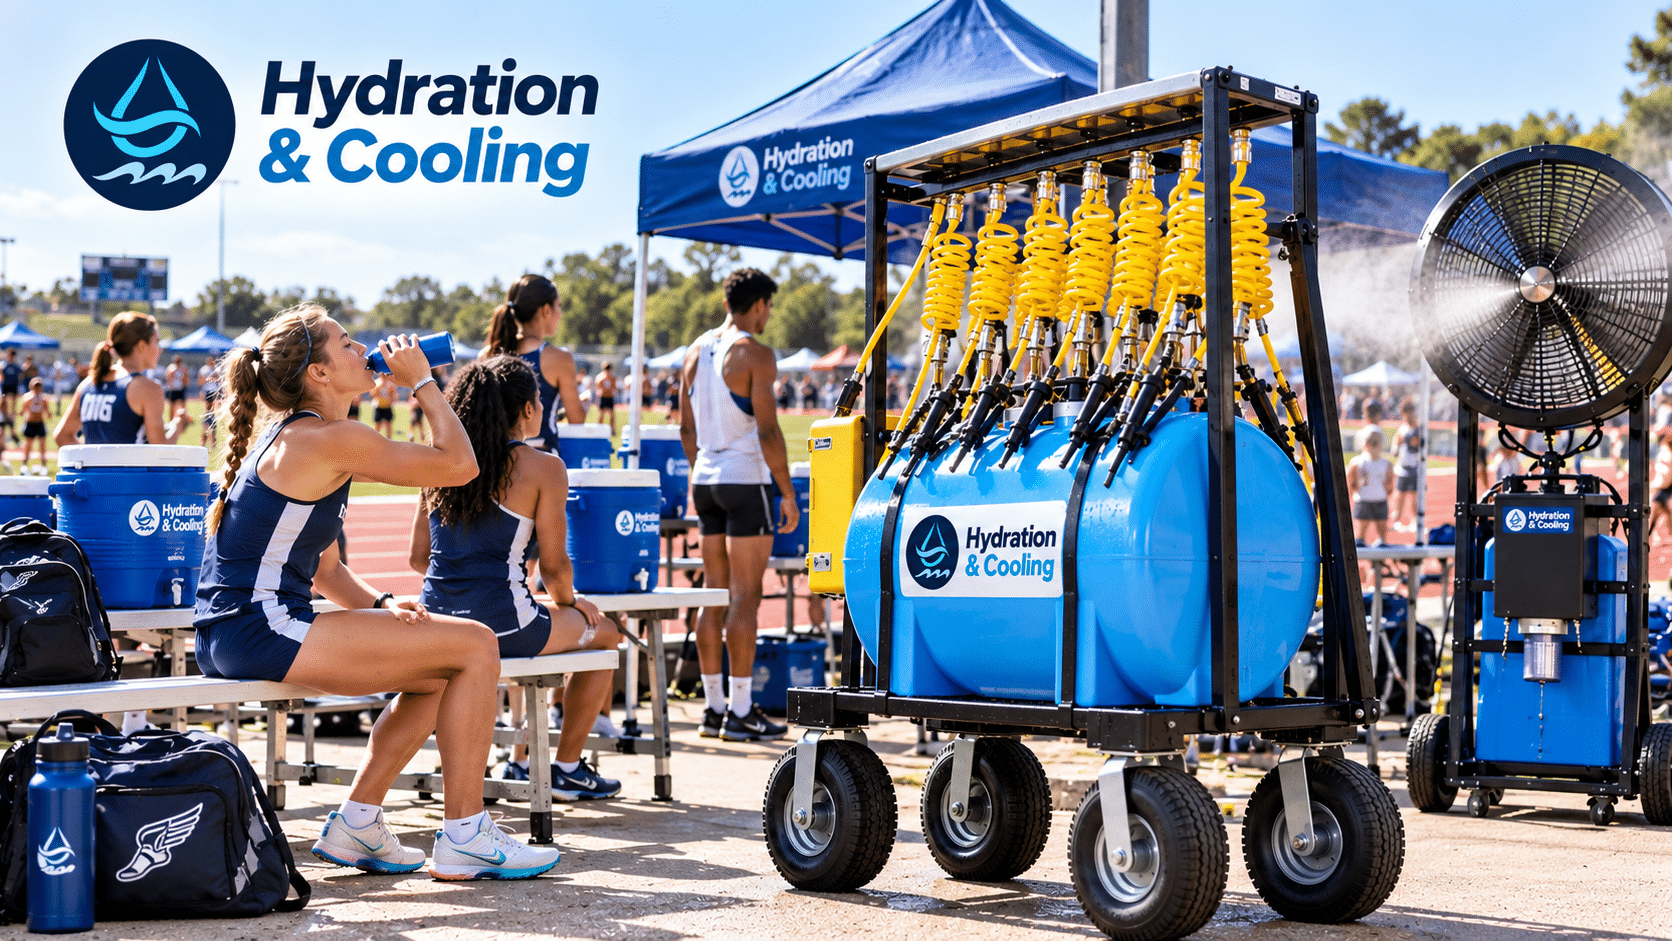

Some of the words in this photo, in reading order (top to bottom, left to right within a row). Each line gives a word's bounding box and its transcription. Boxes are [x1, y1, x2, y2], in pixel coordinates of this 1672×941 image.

[763, 136, 854, 173] Hydration
[763, 172, 777, 195] &
[781, 162, 851, 192] Cooling
[162, 519, 171, 532] &
[1528, 511, 1570, 521] Hydration
[1528, 520, 1536, 529] &
[1537, 520, 1570, 531] Cooling
[966, 525, 1057, 554] Hydration
[965, 554, 980, 577] &
[984, 553, 1055, 582] Cooling
